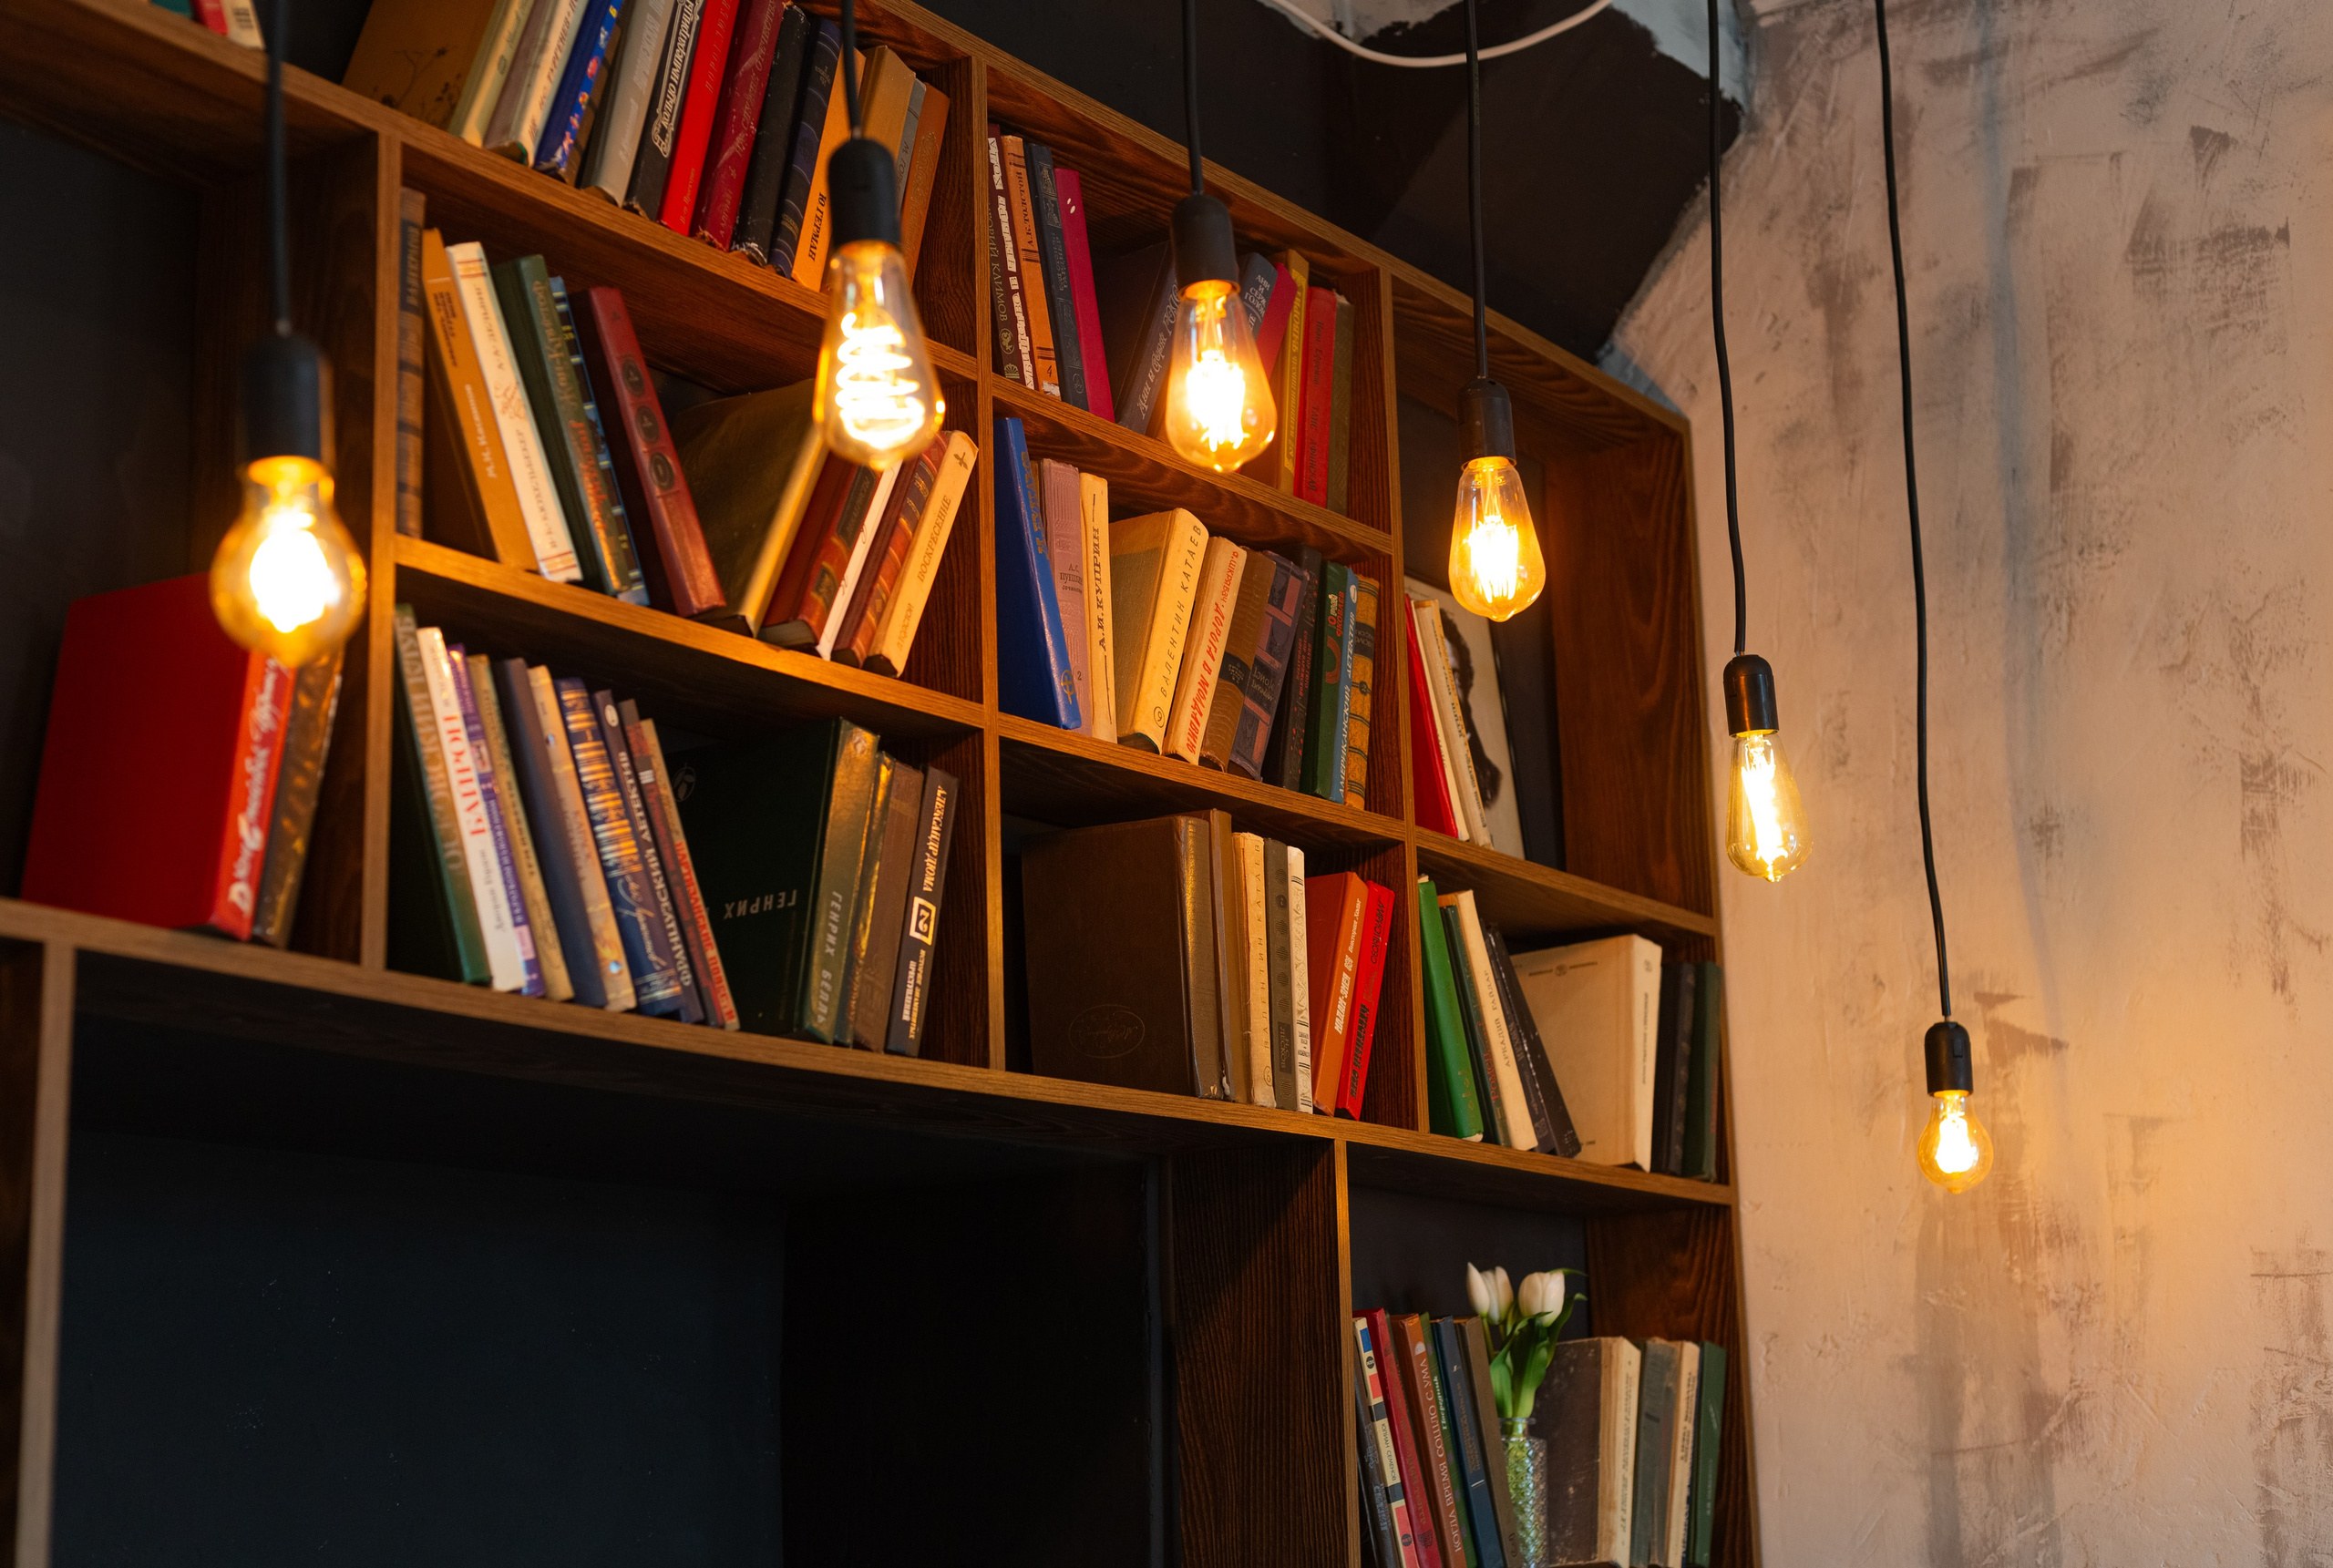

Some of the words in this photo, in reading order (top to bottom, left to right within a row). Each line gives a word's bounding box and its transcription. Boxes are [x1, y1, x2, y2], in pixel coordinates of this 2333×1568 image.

[541, 18, 575, 84] ТУРГЕНЕВ
[987, 138, 1003, 190] ХОДА
[805, 206, 826, 261] ГЕРМАН
[997, 196, 1016, 272] ЧЕТЫРЕ
[991, 260, 1008, 321] КЛИМОВ
[1009, 276, 1018, 288] В
[1256, 274, 1270, 291] АНН
[1259, 284, 1265, 293] И
[1012, 292, 1034, 388] УБИЙСТВО
[1315, 321, 1323, 343] Иван
[1046, 365, 1053, 378] 4
[1312, 348, 1322, 385] Ефремов
[1310, 405, 1319, 429] ТАИС
[1308, 439, 1317, 490] АФИНСКАЯ
[915, 495, 951, 583] ВОСКРЕСЕНИЕ
[1156, 600, 1187, 697] ВАЛЕНТИН
[1178, 524, 1203, 592] КАТАЕВ
[1202, 602, 1228, 661] ДОРОГА
[1336, 591, 1344, 637] ЯКОВЛЕВ
[1291, 637, 1305, 680] БОГОМАТЕРИ
[1300, 630, 1310, 653] СОБОР
[1304, 642, 1314, 669] ВИКТОР
[1077, 671, 1083, 681] 2
[1200, 660, 1214, 673] В
[1295, 654, 1310, 696] ПАРИЖСКОЙ
[1301, 670, 1310, 688] ГЮГО
[1181, 673, 1212, 754] МОЛДАВИЮ
[1335, 684, 1352, 796] АМЕРИКАНСКИЙ
[1344, 611, 1356, 678] ДЕТЕКТИВ
[437, 713, 489, 837] БАЙРОН
[616, 750, 652, 844] ДЕТЕКТИВ
[925, 784, 947, 856] АЛЕКСАНДР
[920, 854, 937, 892] ДЮМА
[1252, 843, 1263, 922] КАТАЕВ
[642, 846, 693, 987] ФРАНЦУЗСКИЙ
[720, 888, 799, 918] ГЕНРИХ
[821, 890, 845, 957] ГЕНРИХ
[1351, 897, 1362, 919] Холт
[1346, 919, 1360, 953] Виктория
[900, 960, 917, 1020] ПРЕСТУПЛЕНИЙ
[1257, 937, 1269, 1048] ВАЛЕНТИН
[1331, 970, 1354, 1034] МАДАМ-ЗМЕЯ
[1482, 968, 1497, 1010] ГАЙДАР
[1350, 1002, 1372, 1069] КРЕСТНЫЙ
[1494, 1017, 1511, 1068] АРКАДИЙ
[1419, 1357, 1432, 1386] УМА
[1424, 1389, 1434, 1400] С
[1432, 1374, 1448, 1430] Посредник
[1380, 1422, 1391, 1448] ЮЛИАН
[1427, 1404, 1444, 1458] СОШЛО
[1385, 1450, 1397, 1481] СЕМЕНОВ
[1438, 1460, 1454, 1506] ВРЕМЯ
[1446, 1508, 1463, 1552] КОГДА
